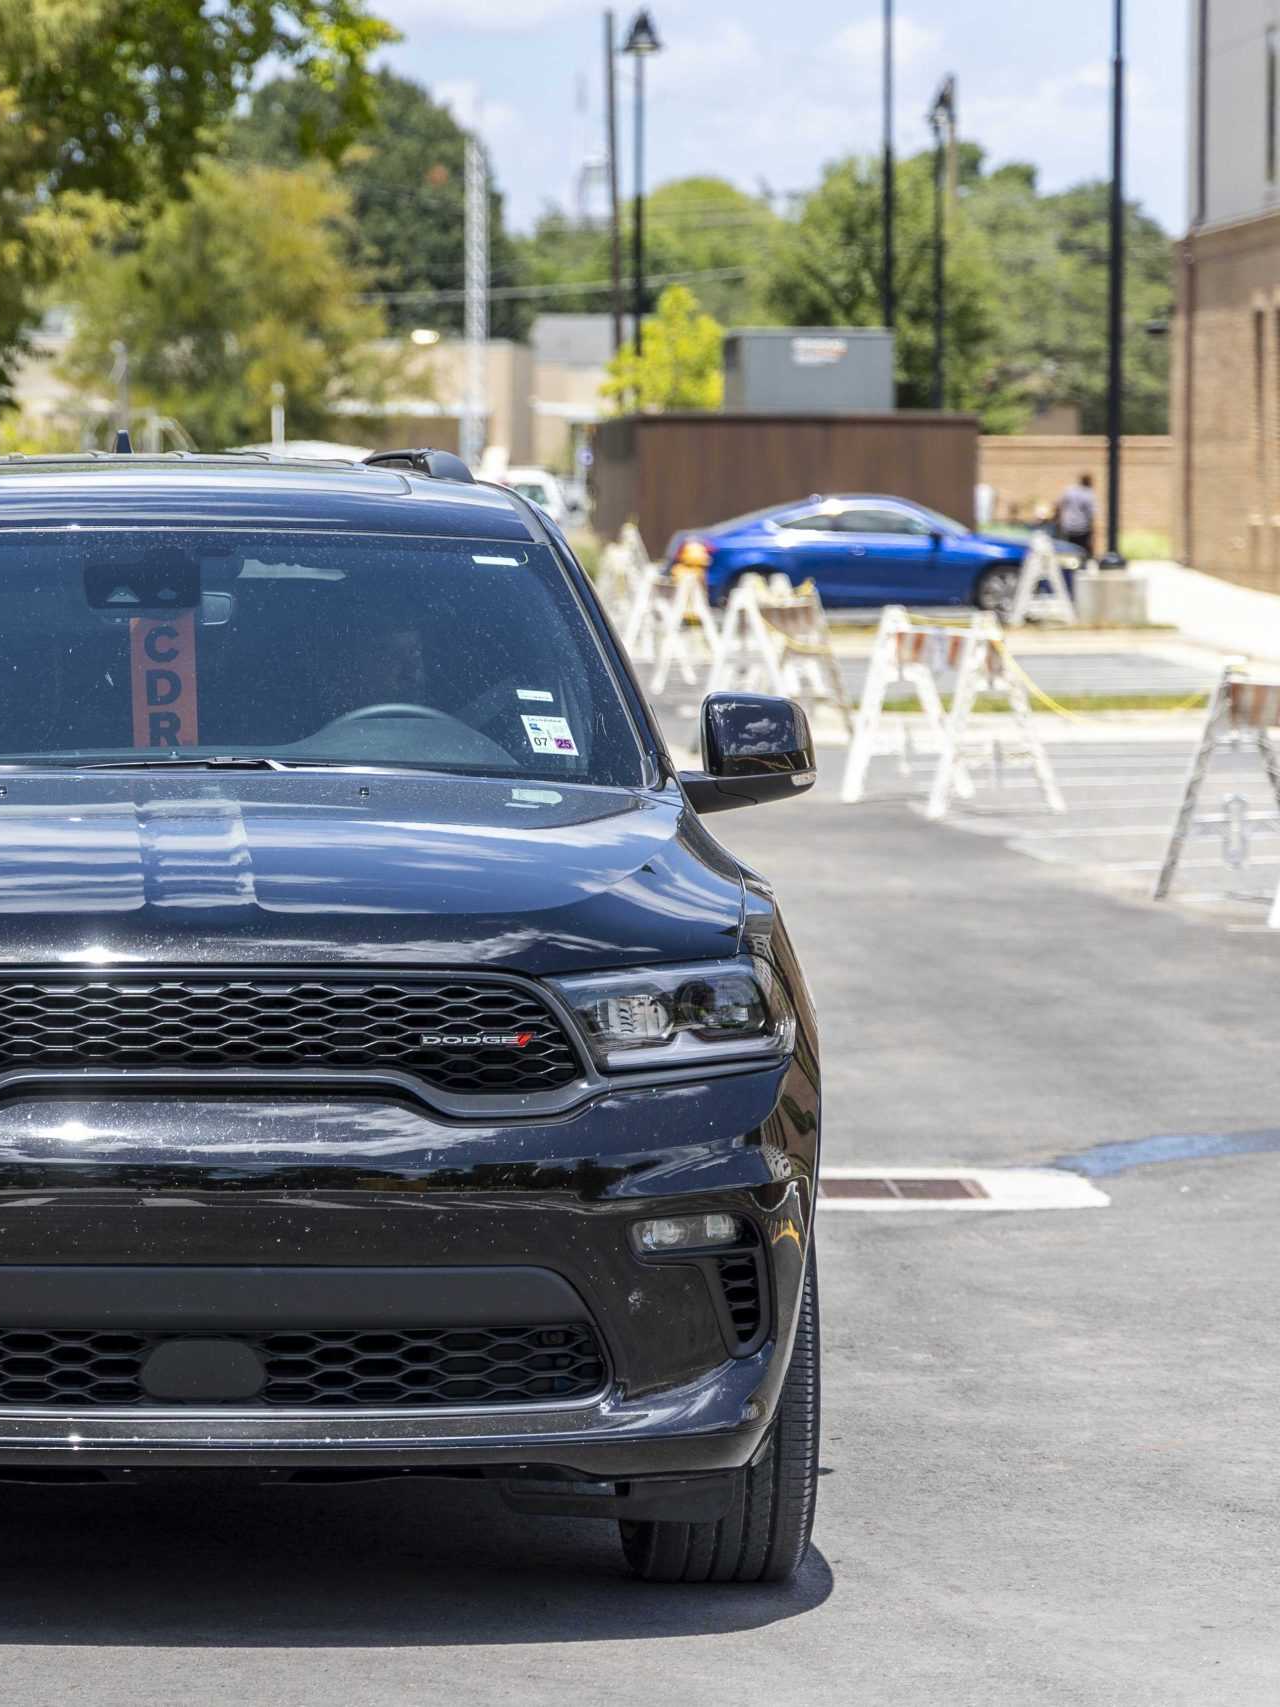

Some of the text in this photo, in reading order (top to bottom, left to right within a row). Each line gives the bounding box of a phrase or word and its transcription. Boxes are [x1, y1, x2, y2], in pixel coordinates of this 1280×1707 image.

[534, 737, 573, 750] 07 25
[422, 1036, 520, 1045] DODGE
